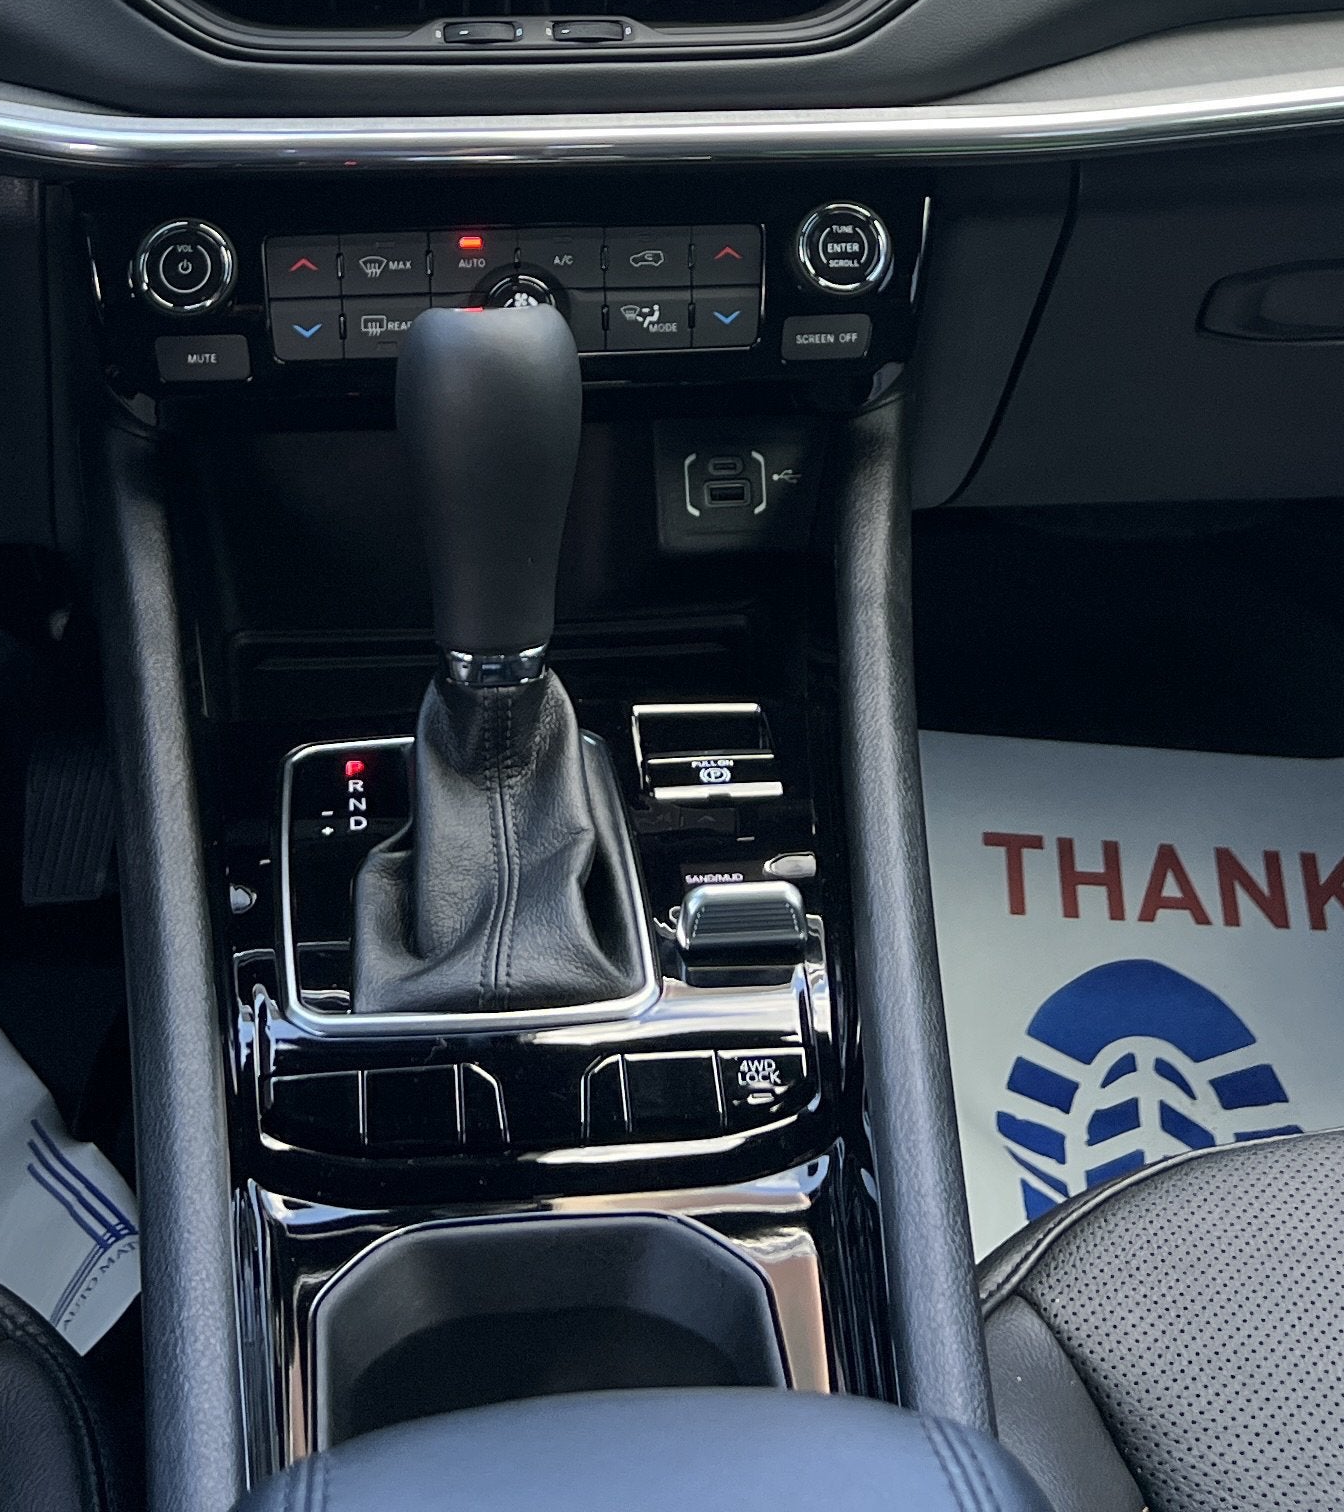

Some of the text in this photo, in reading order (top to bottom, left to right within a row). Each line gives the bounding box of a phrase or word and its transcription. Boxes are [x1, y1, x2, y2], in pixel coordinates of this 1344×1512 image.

[831, 224, 854, 234] TUNE
[176, 243, 194, 253] VOL
[827, 242, 860, 253] ENTER
[389, 260, 413, 271] MAX
[458, 258, 486, 268] AUTO
[553, 254, 575, 266] A/C
[828, 259, 860, 268] SCROLL
[648, 322, 678, 333] MODE
[795, 332, 859, 345] SCREEN OFF
[187, 352, 218, 364] MUTE
[345, 760, 365, 776] P
[347, 779, 364, 793] R
[348, 797, 367, 811] N
[349, 815, 368, 831] D
[739, 1058, 777, 1073] 4WD
[737, 1069, 782, 1086] LOCK
